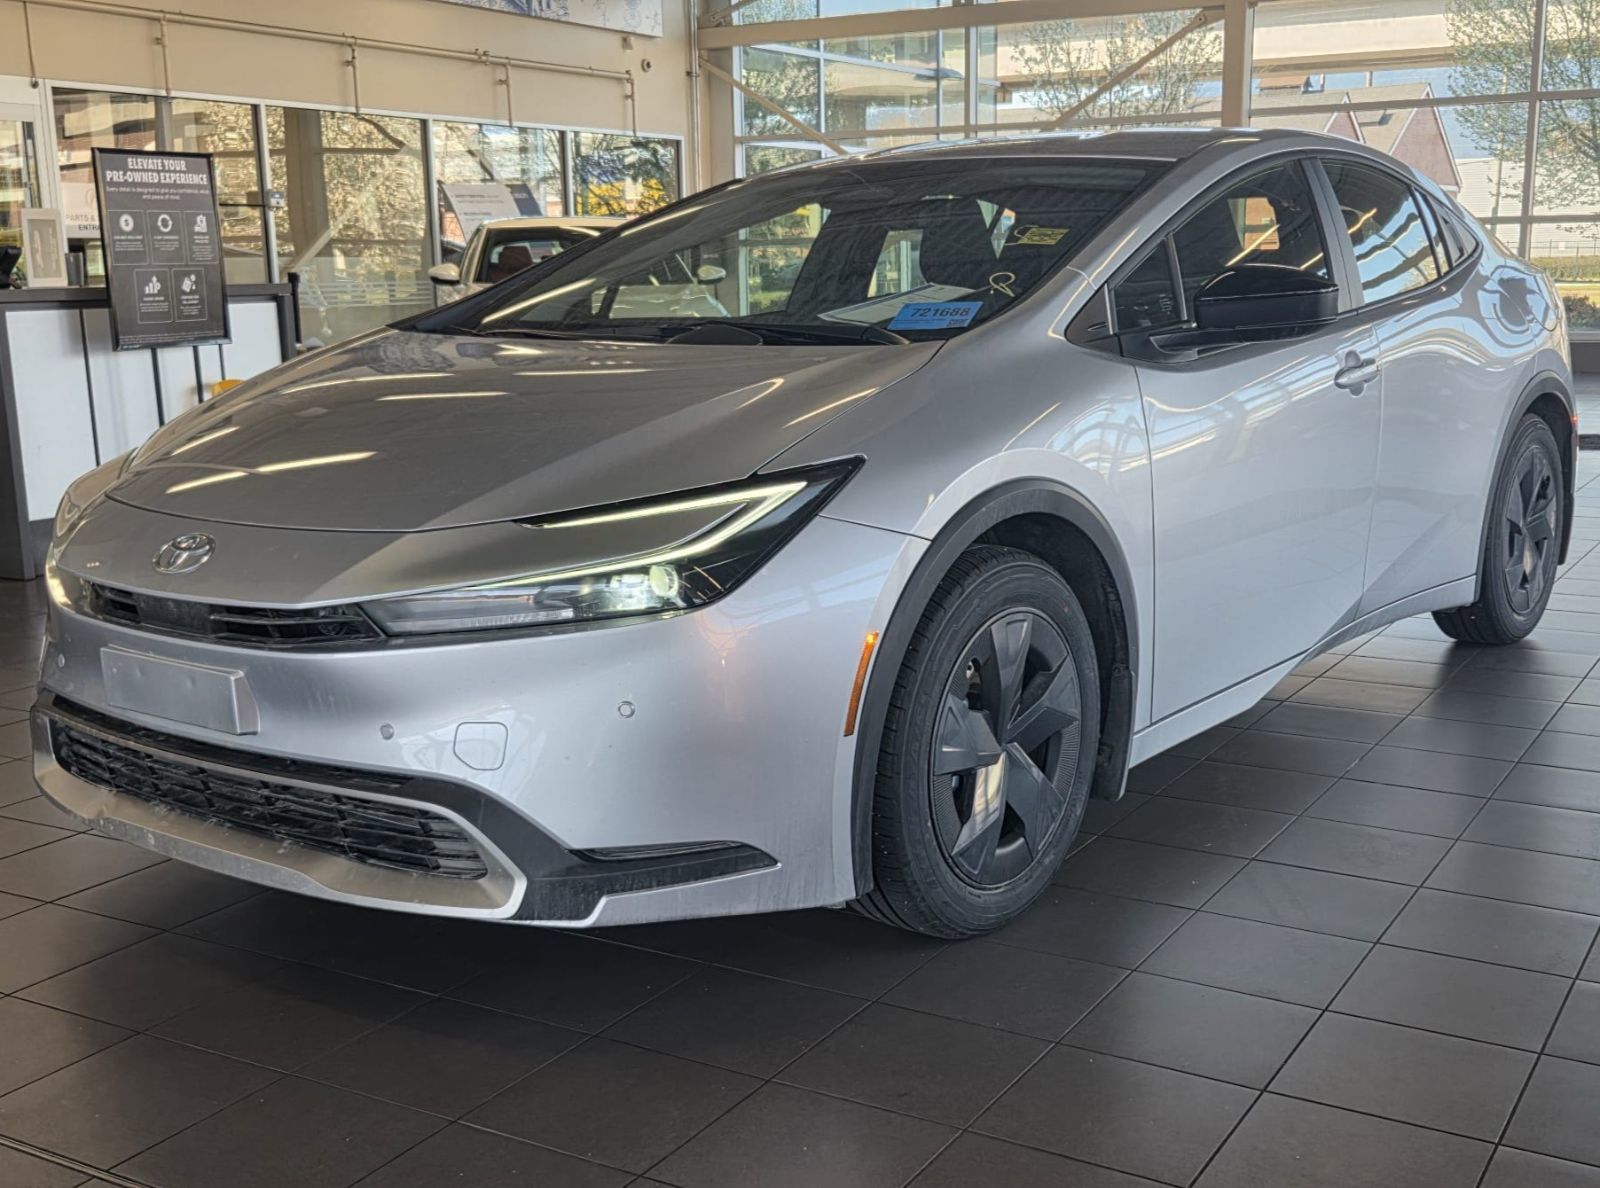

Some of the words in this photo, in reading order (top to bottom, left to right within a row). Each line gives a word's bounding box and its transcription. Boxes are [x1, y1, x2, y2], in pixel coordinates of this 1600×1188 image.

[128, 158, 163, 170] ELEVATE
[163, 160, 187, 170] YOUR
[106, 170, 158, 182] PRE-OWNED
[160, 173, 208, 184] EXPERIENCE
[66, 214, 88, 222] PARTS
[910, 307, 970, 318] 721688
